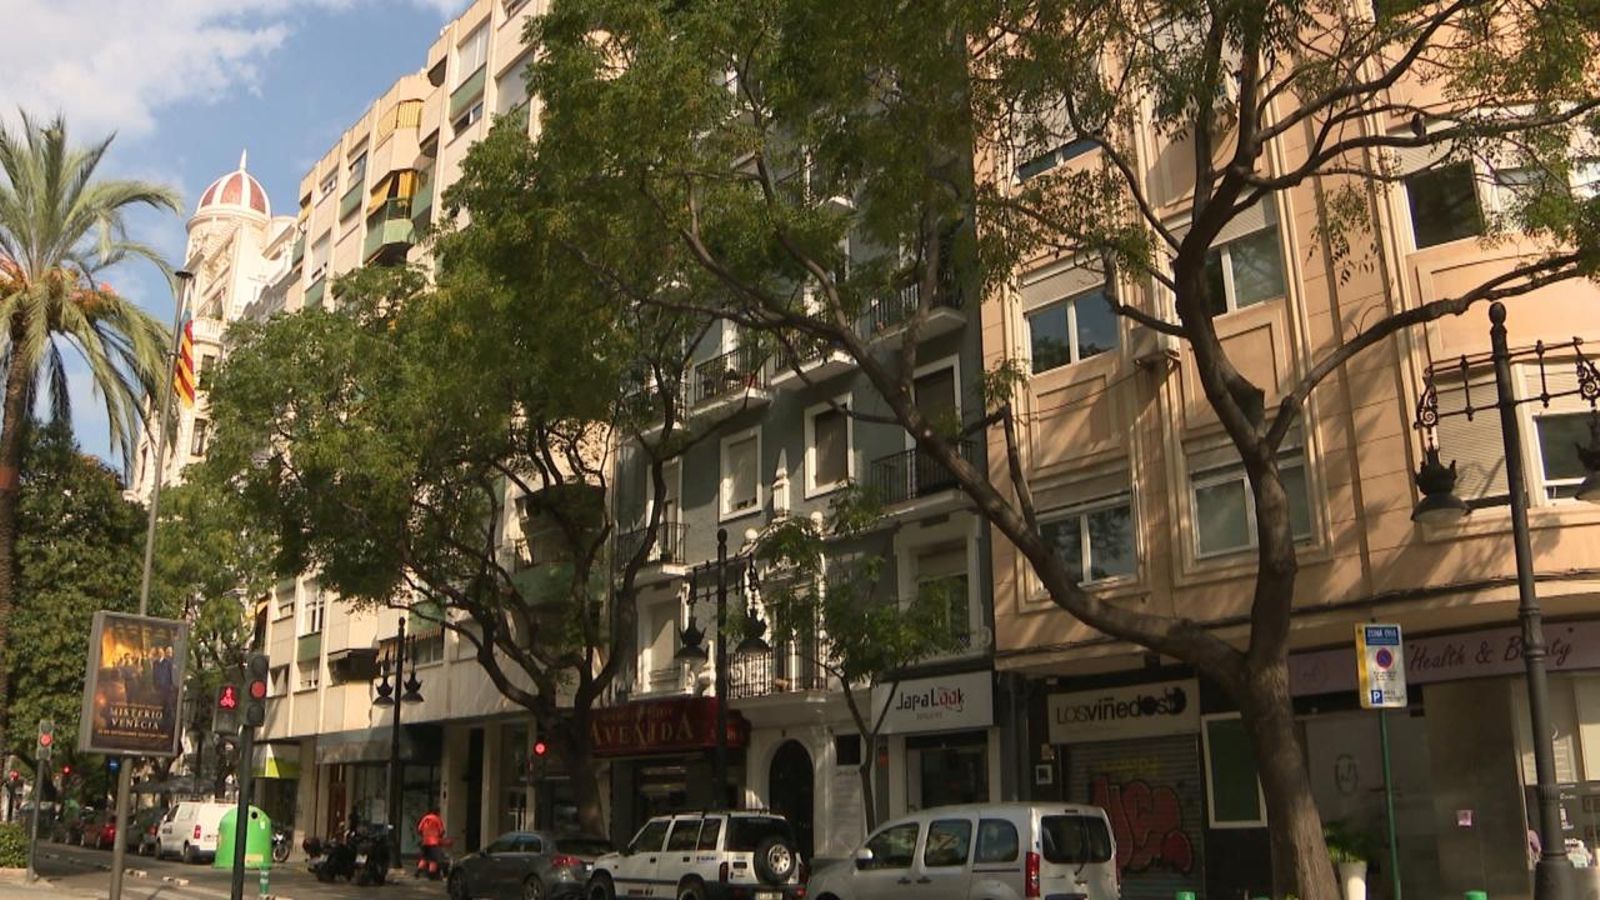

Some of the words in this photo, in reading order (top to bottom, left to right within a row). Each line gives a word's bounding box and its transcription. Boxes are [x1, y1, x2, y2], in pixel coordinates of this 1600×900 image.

[1475, 640, 1494, 664] &
[1373, 691, 1381, 703] P
[110, 706, 163, 719] MISTERIO
[111, 717, 159, 730] VENECIA
